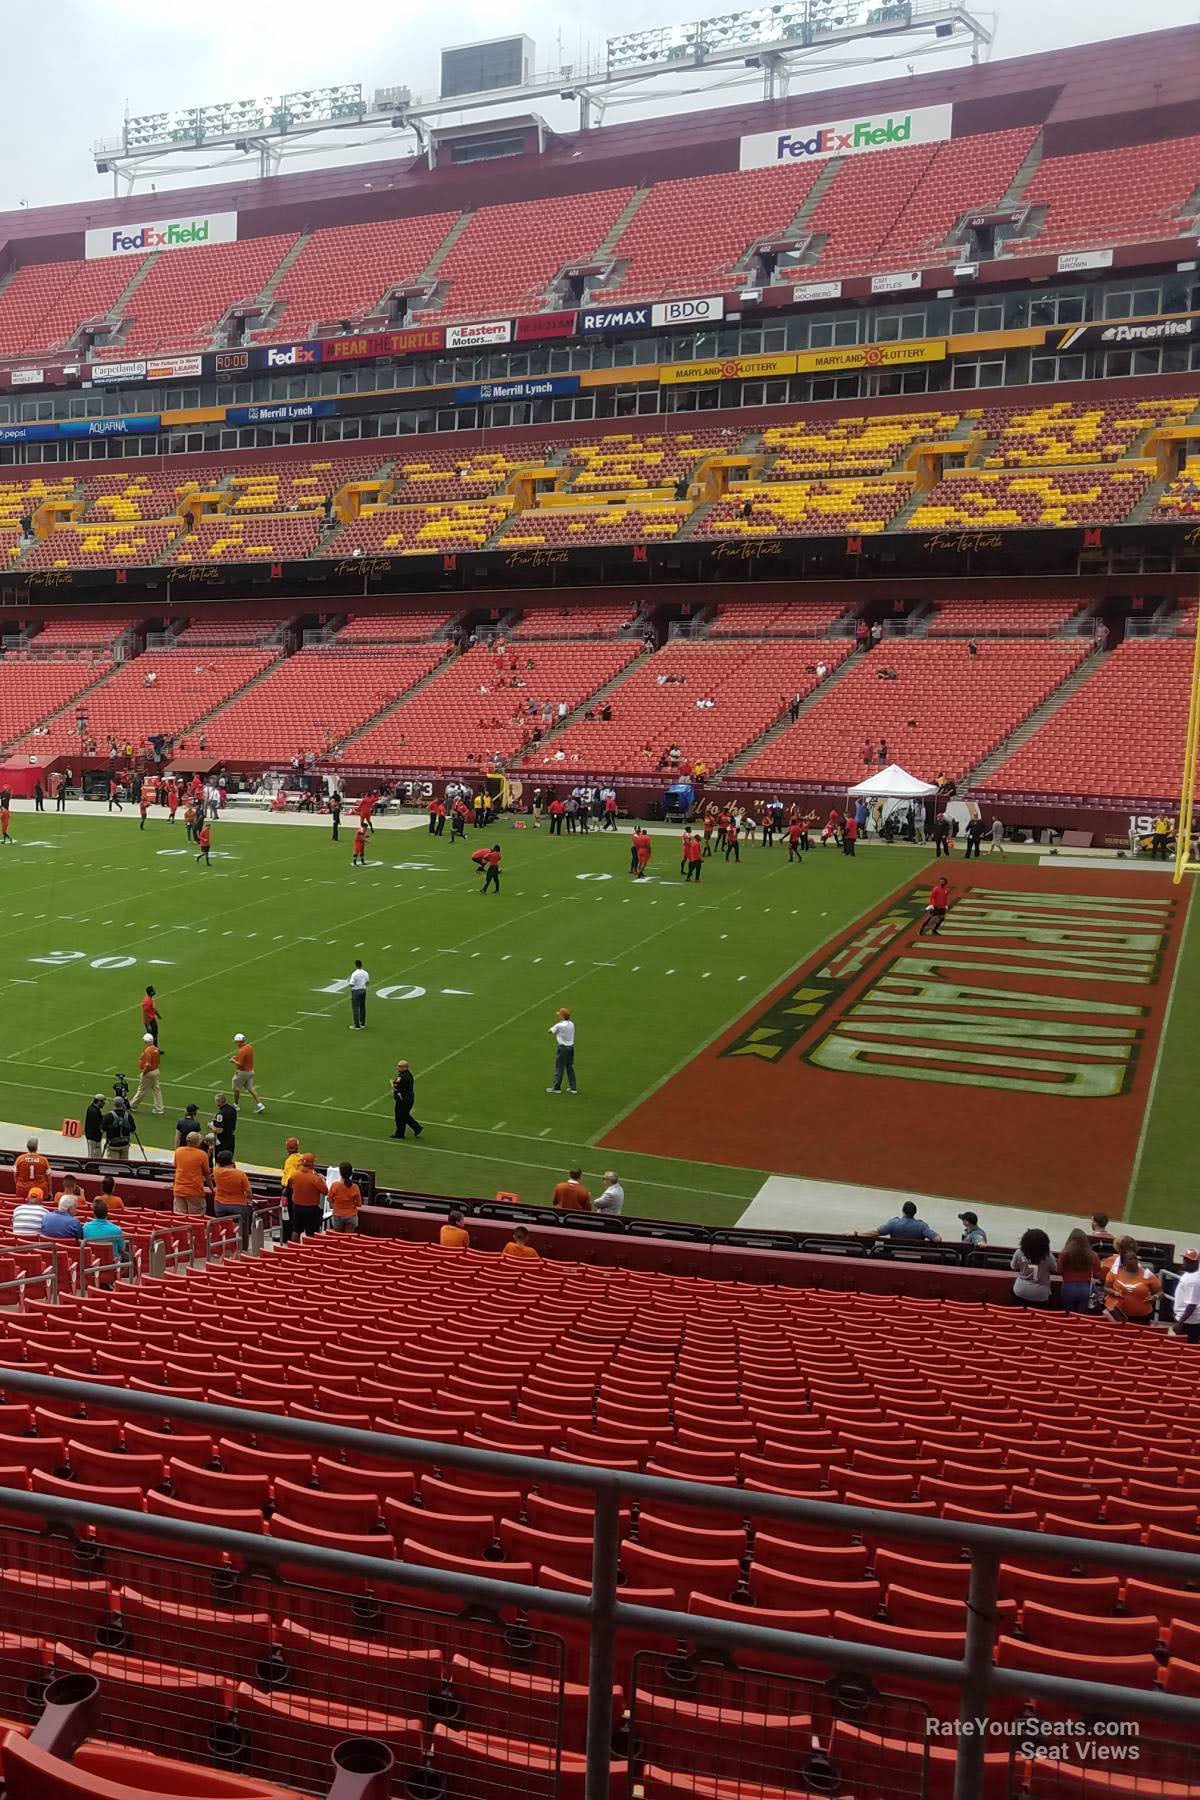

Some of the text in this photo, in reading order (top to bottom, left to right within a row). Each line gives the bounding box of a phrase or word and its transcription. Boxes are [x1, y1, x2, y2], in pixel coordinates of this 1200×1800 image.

[777, 113, 911, 160] FedExField
[112, 220, 208, 252] FedExField
[670, 300, 711, 318] BDO
[584, 309, 646, 329] RE/MAX
[460, 325, 506, 337] Eastern
[267, 346, 314, 367] FedEx
[815, 348, 927, 367] MARYLAND LOTTERY
[94, 363, 136, 375] Carpetland
[174, 364, 199, 373] LEARN
[675, 361, 777, 379] MARYLAND LOTTERY
[493, 381, 553, 397] Merrill Lynch
[260, 406, 313, 419] Merrill Lynch
[4, 428, 27, 439] pepsi
[28, 950, 138, 970] 20
[310, 978, 427, 1000] 10
[64, 1120, 79, 1137] 10
[29, 1165, 35, 1179] 1
